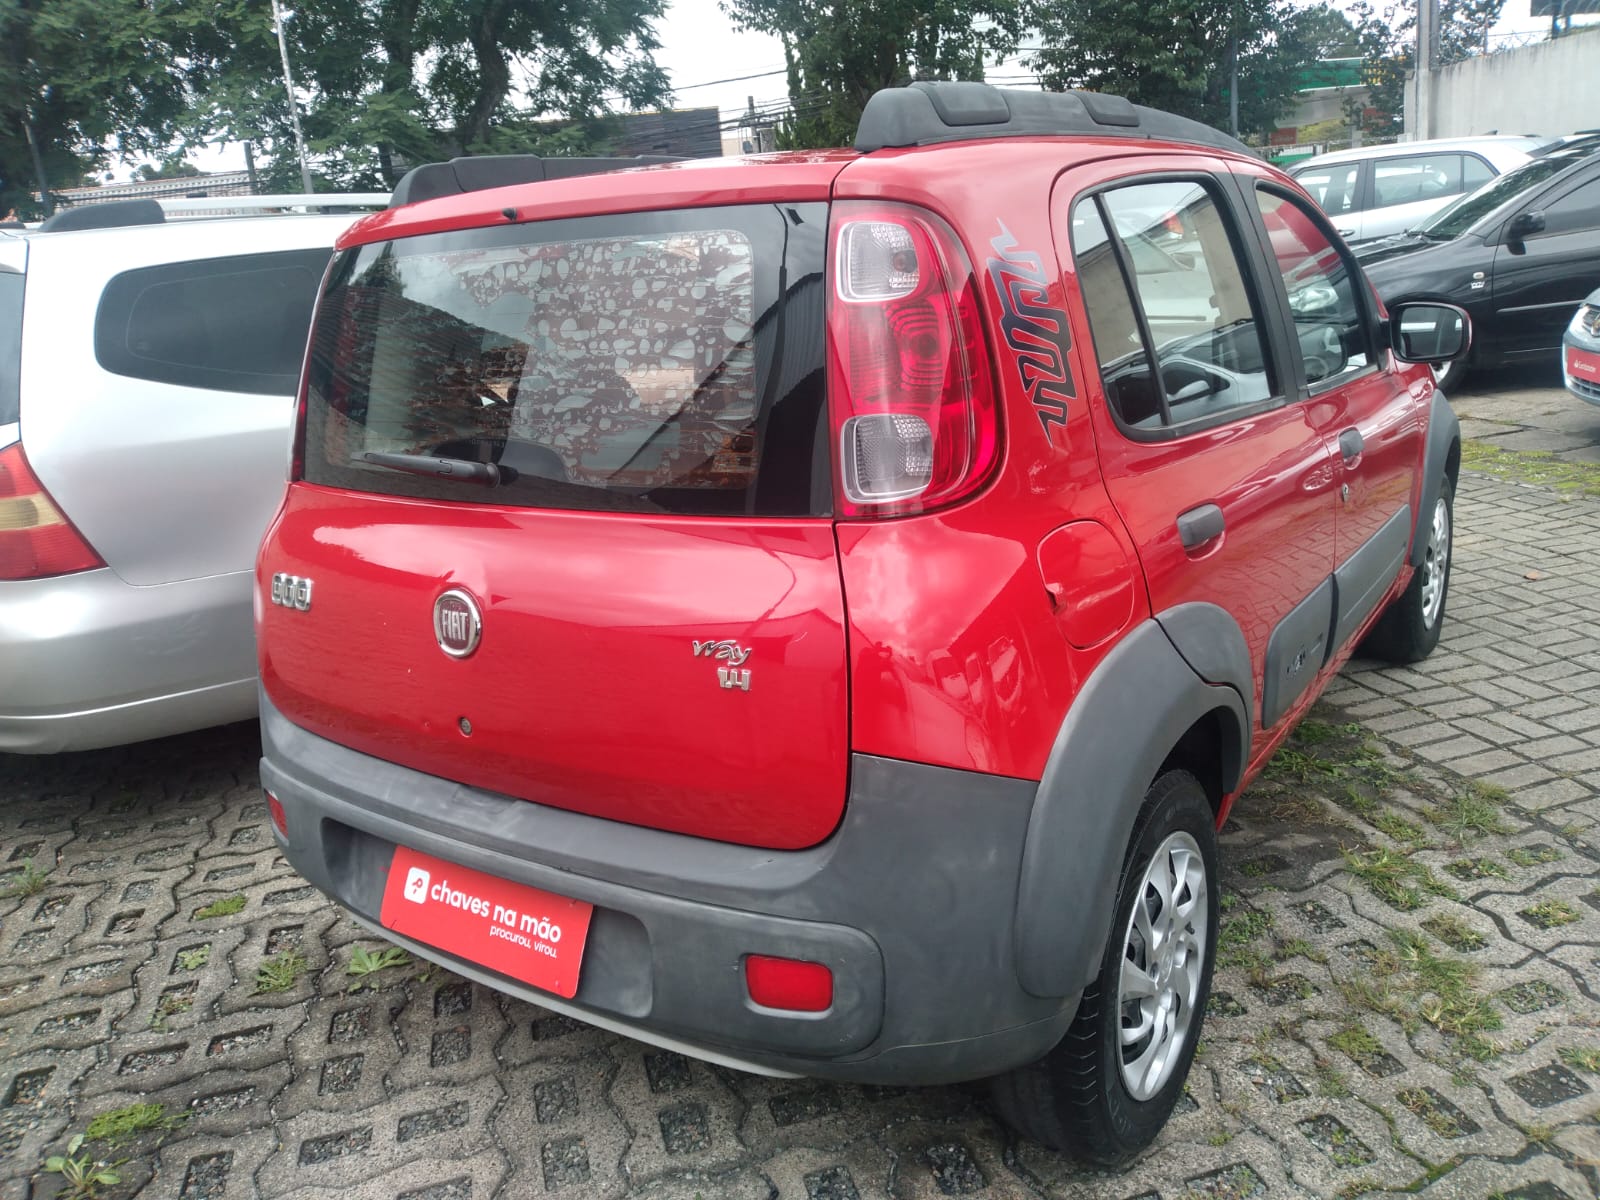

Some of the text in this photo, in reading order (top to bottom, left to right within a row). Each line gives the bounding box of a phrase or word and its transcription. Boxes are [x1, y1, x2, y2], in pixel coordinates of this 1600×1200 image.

[442, 608, 468, 641] FIAT
[431, 880, 562, 943] chaves na mão
[489, 925, 532, 949] procurou,
